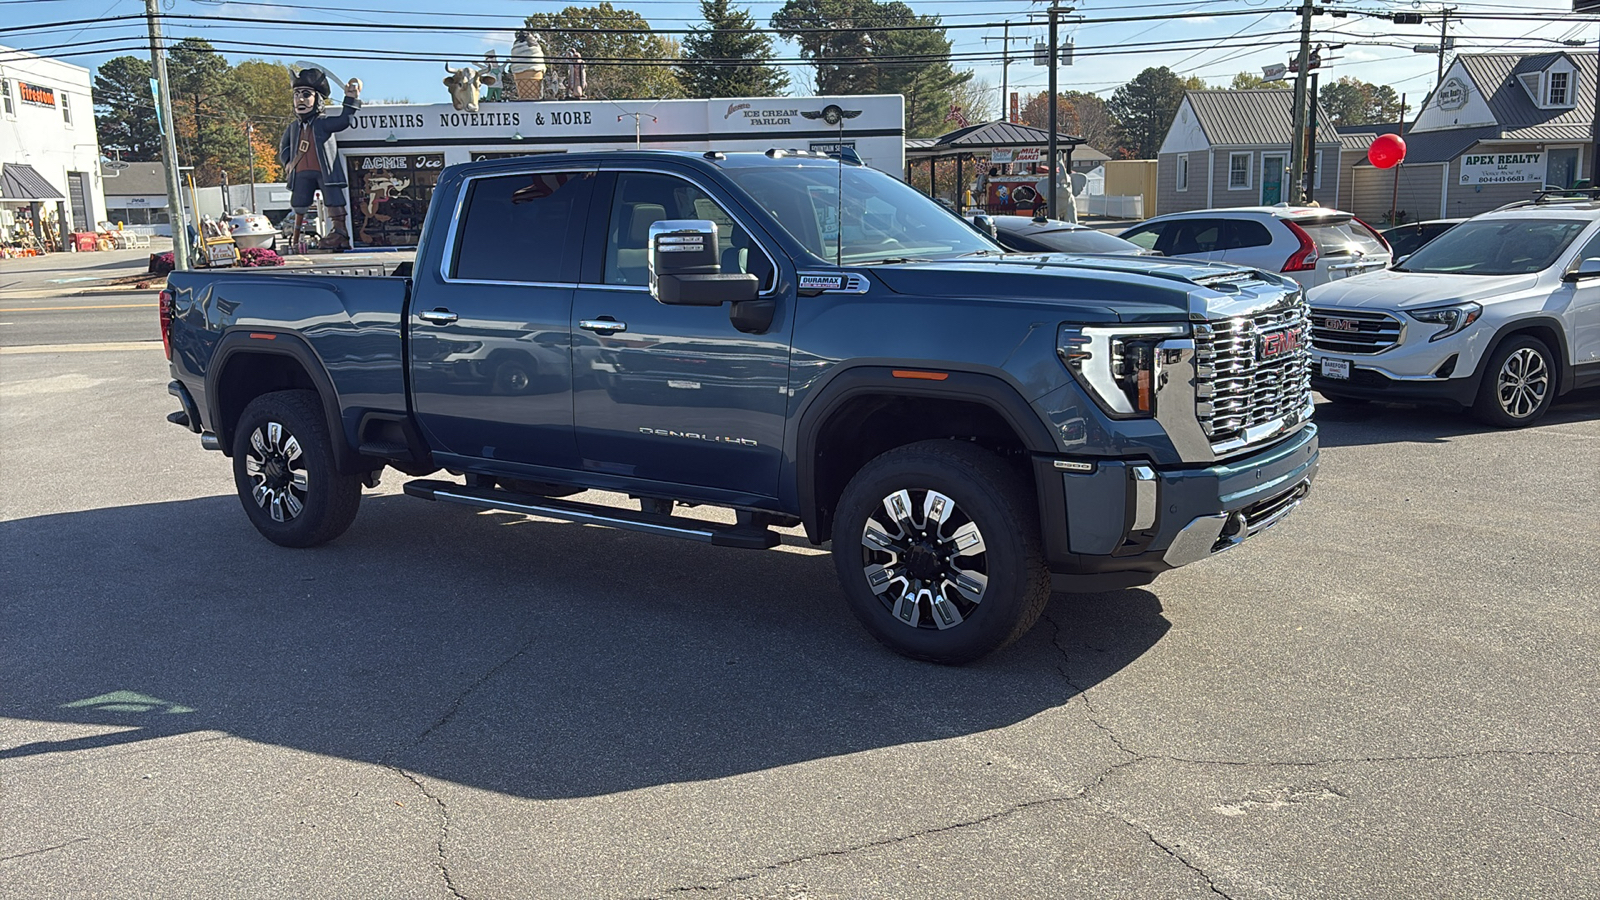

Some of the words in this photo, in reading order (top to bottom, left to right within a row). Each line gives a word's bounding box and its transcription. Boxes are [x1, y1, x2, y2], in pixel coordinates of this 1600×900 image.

[18, 82, 55, 105] Firestone
[762, 109, 798, 117] CREAM
[350, 114, 424, 130] OUVENIRS
[439, 112, 520, 127] NOVELTIES
[535, 112, 545, 126] &
[550, 111, 592, 125] MORE
[750, 118, 791, 126] PARLOR
[361, 156, 408, 170] ACME
[415, 155, 443, 169] Ice
[1465, 155, 1495, 166] APEX
[1498, 154, 1541, 164] REALTY
[1478, 175, 1526, 183] 804-443-6683
[1325, 318, 1360, 332] GMC
[1264, 329, 1303, 356] GMC
[639, 427, 720, 443] DENALI
[724, 436, 758, 447] HD
